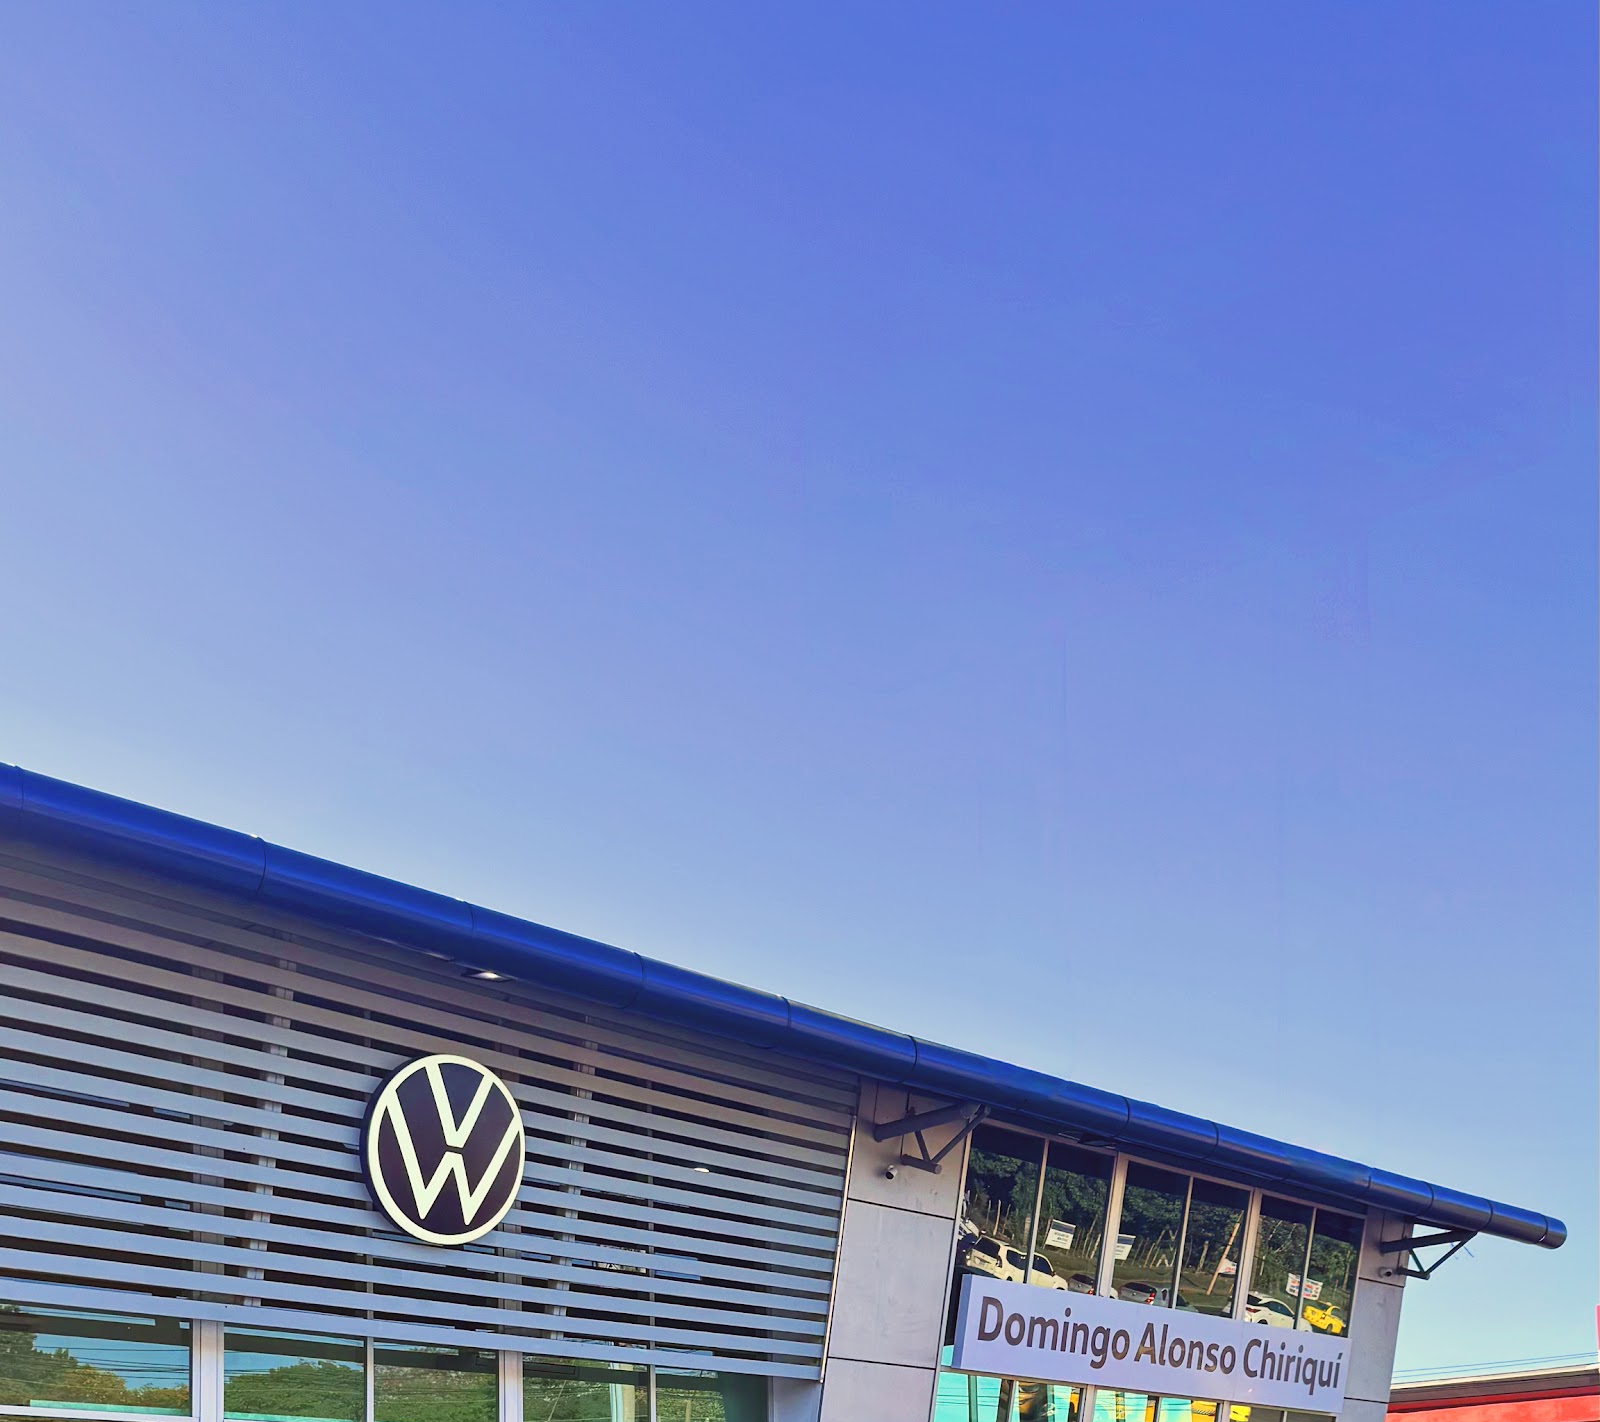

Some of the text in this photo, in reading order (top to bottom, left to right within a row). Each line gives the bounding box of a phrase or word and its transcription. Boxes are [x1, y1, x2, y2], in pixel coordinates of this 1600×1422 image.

[373, 1058, 522, 1238] VW
[977, 1296, 1343, 1396] Domingo Alonso Chiriquí
